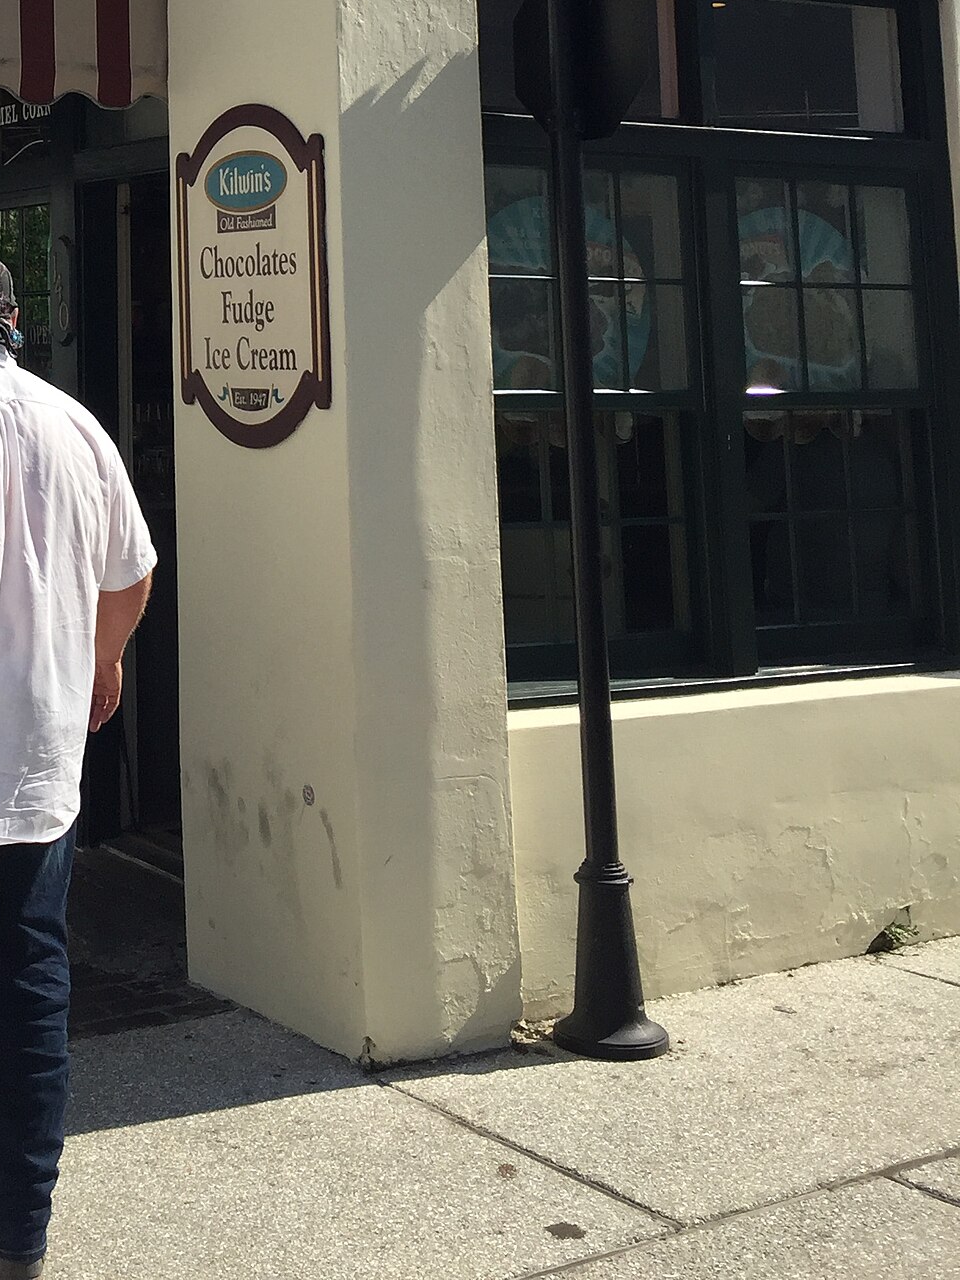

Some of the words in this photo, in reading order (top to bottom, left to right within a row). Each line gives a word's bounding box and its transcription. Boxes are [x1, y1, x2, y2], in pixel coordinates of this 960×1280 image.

[218, 163, 271, 197] Kilwin's
[220, 216, 234, 231] Old
[236, 213, 273, 230] Fashioned
[200, 241, 297, 280] Chocolates
[221, 289, 275, 332] Fudge
[29, 323, 50, 345] OPE
[204, 337, 231, 370] Ice
[236, 336, 298, 371] Cream
[234, 391, 246, 406] Est.
[249, 391, 267, 407] 1947
